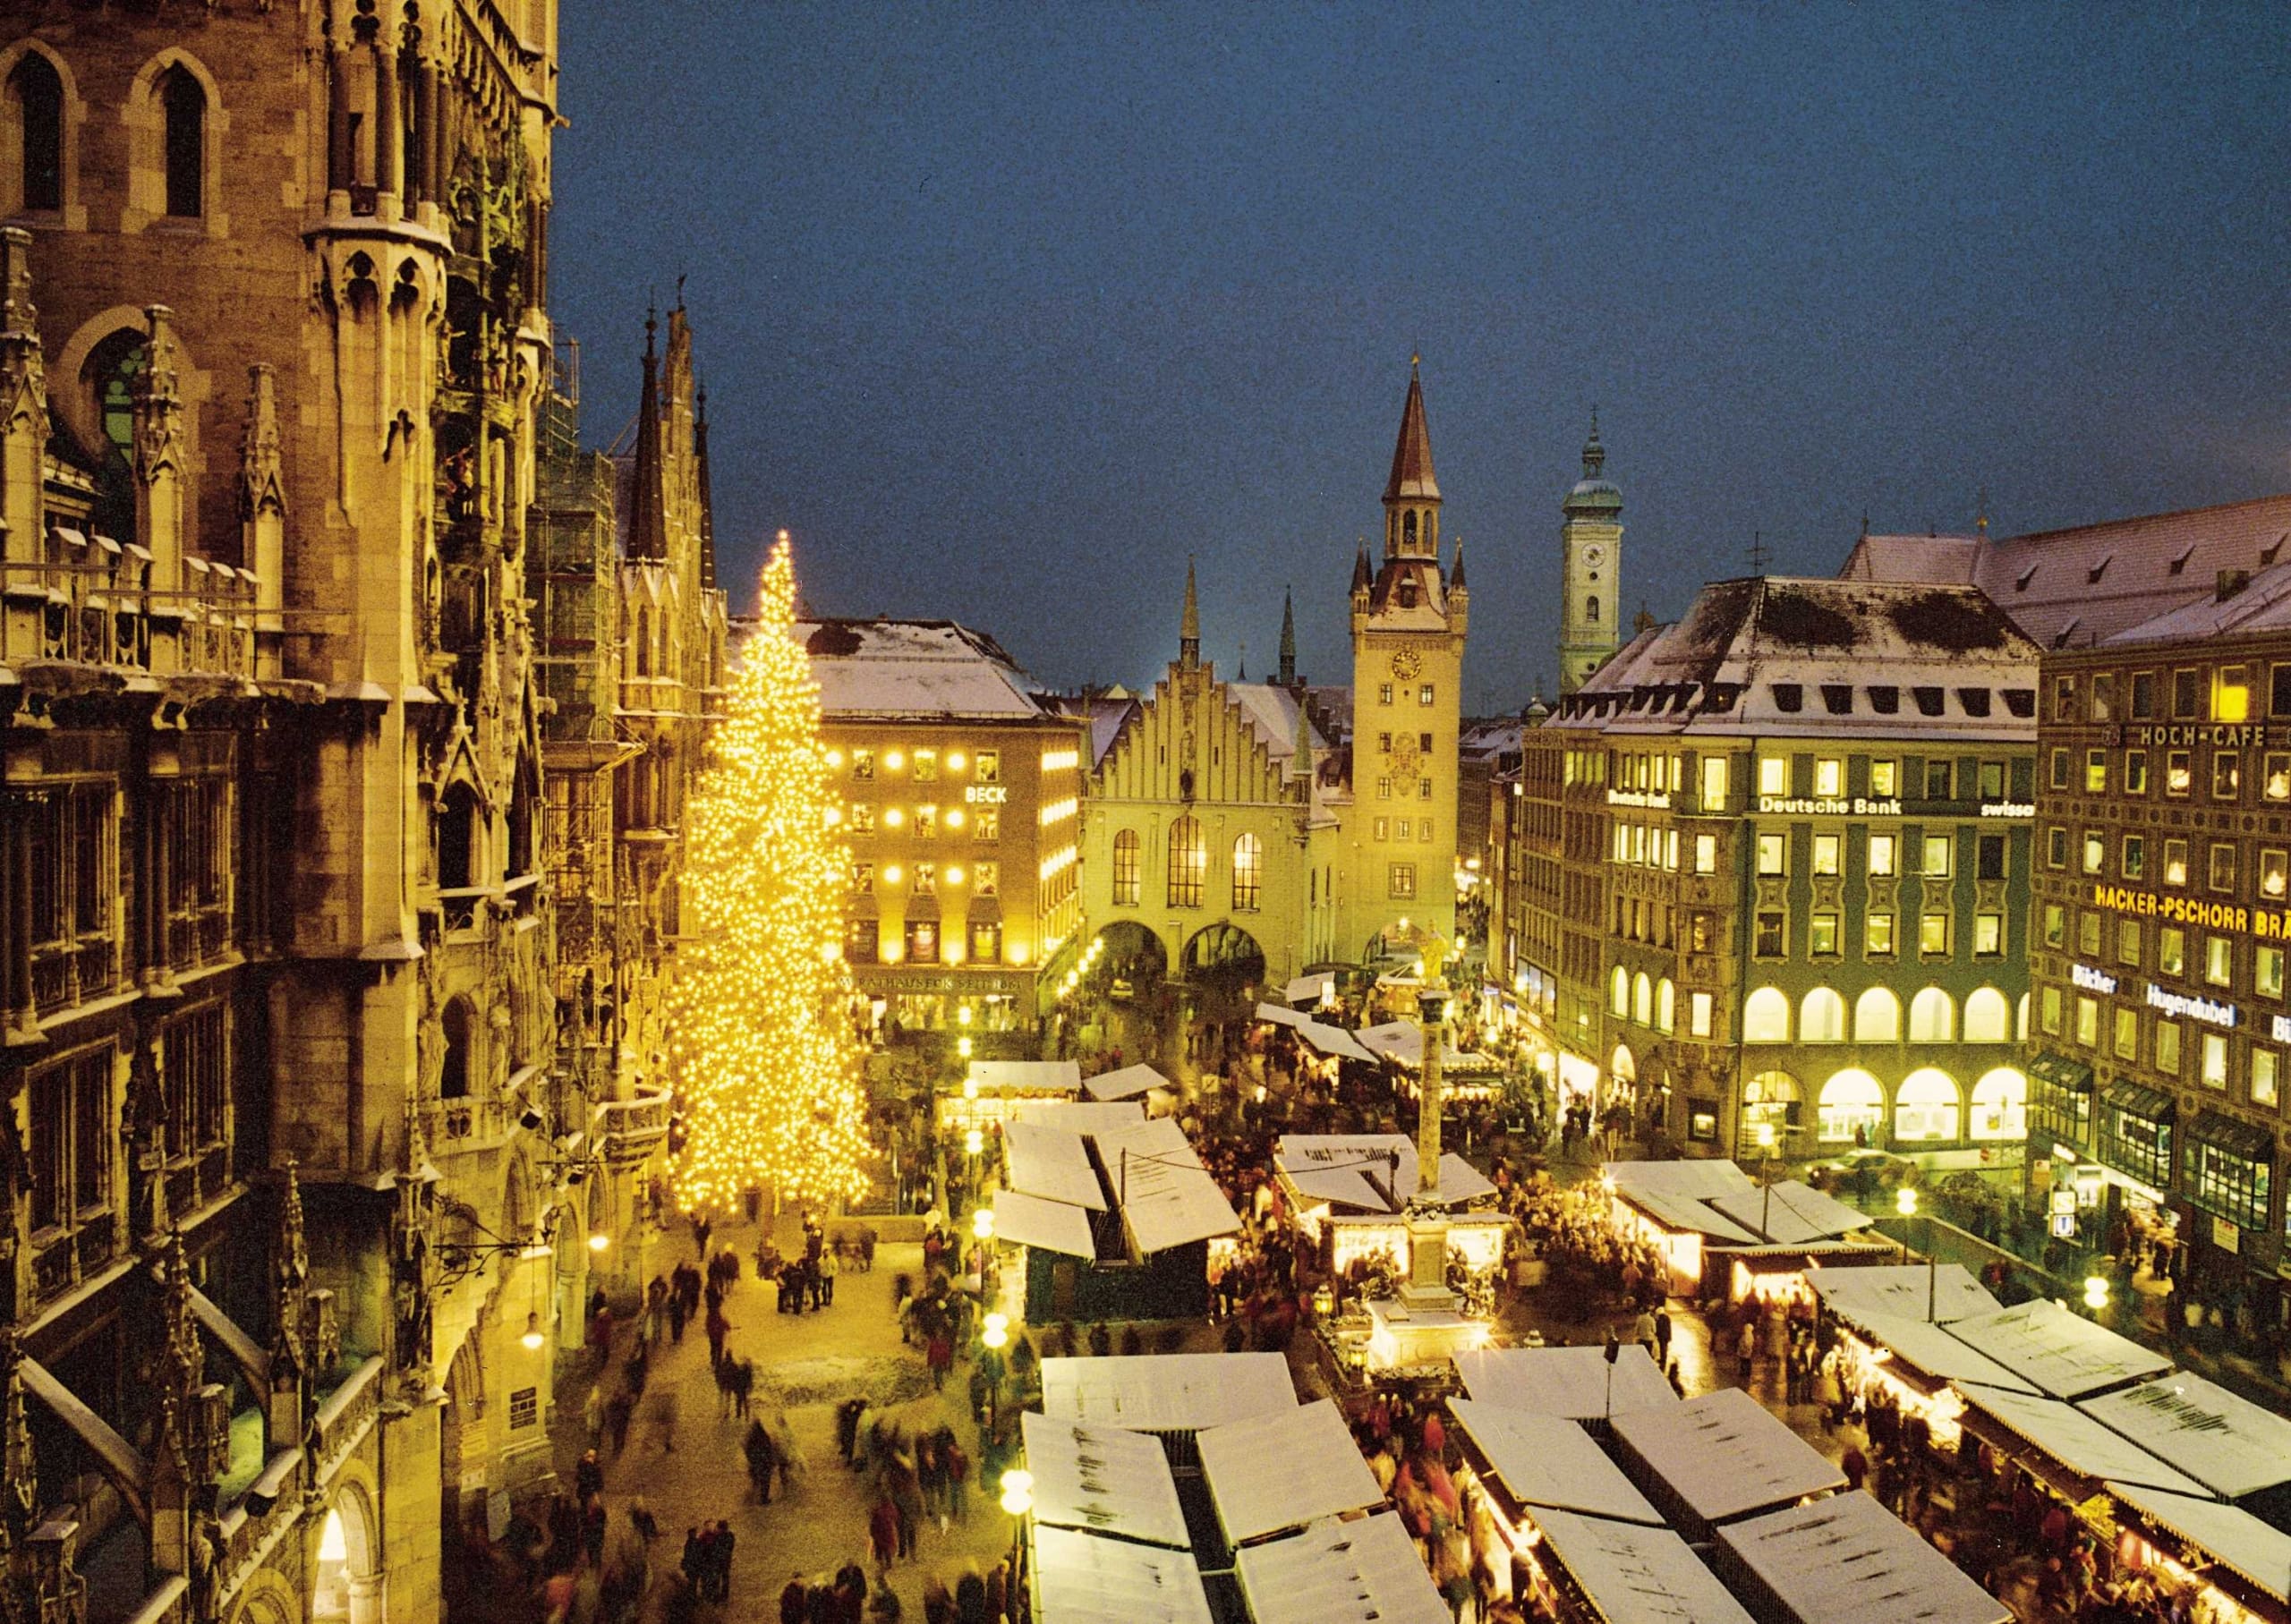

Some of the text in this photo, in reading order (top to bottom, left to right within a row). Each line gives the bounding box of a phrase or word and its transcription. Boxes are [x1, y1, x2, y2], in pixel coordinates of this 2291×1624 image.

[965, 786, 1008, 803] BECK
[1759, 795, 1902, 815] Deutsche Bank
[2094, 884, 2248, 932] HACKER-PSCHORR
[2073, 964, 2116, 994] Bücher
[2147, 982, 2236, 1028] Hugendubel
[2057, 1216, 2073, 1236] U
